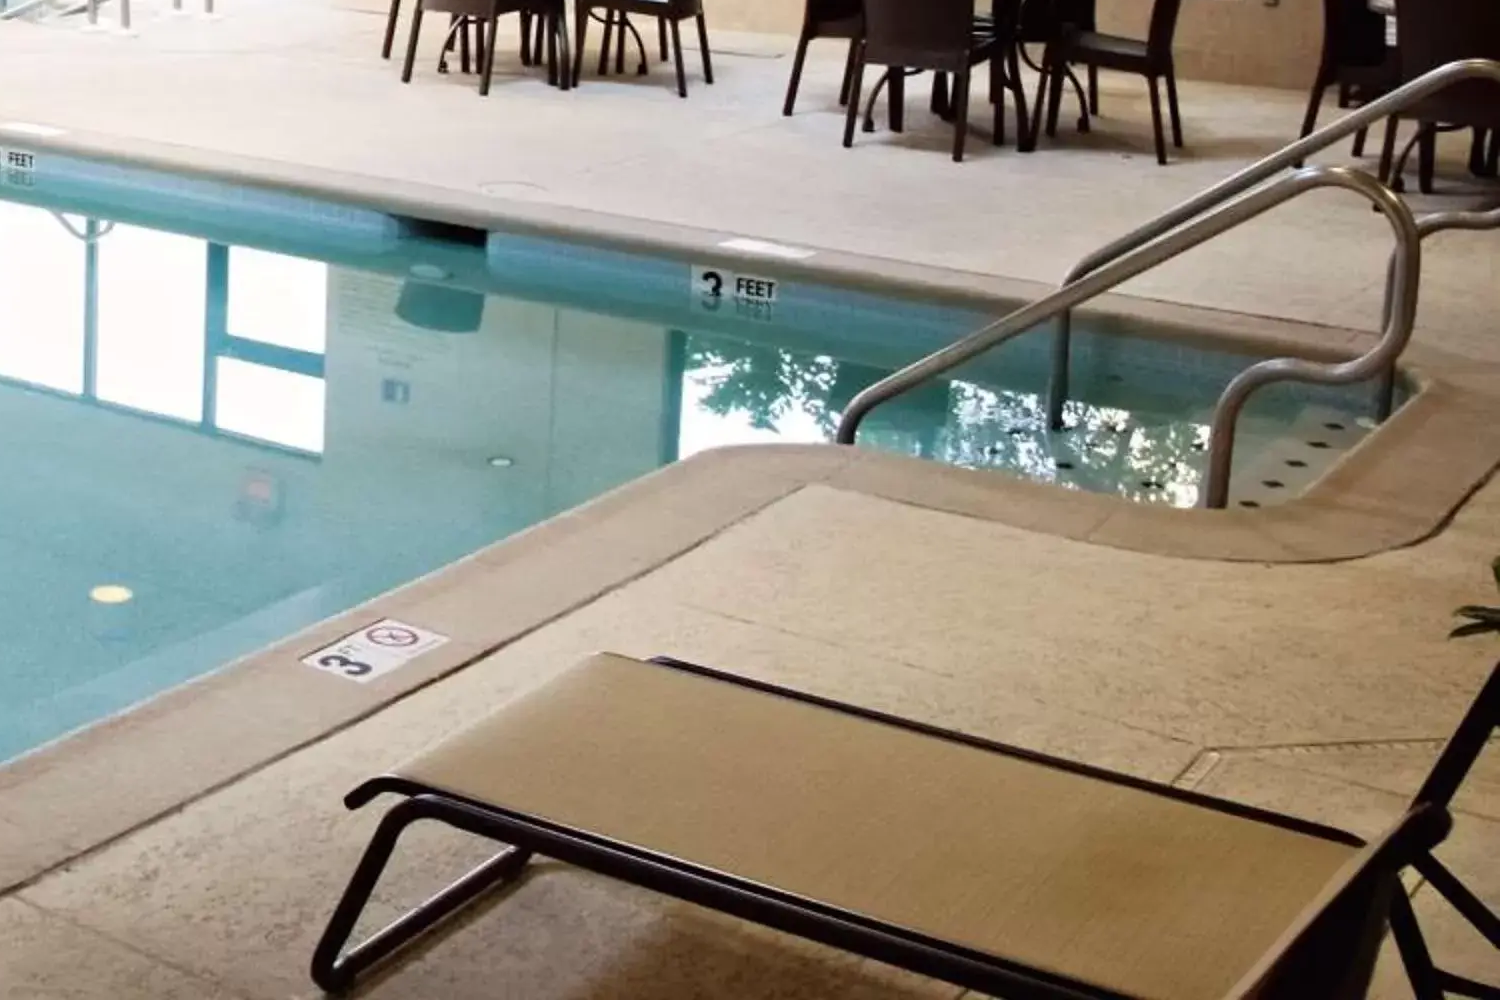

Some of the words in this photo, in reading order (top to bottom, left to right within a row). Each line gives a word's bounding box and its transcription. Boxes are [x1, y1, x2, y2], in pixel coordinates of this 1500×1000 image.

[8, 152, 33, 168] FEET
[736, 277, 775, 299] FEET
[318, 655, 373, 676] 3
